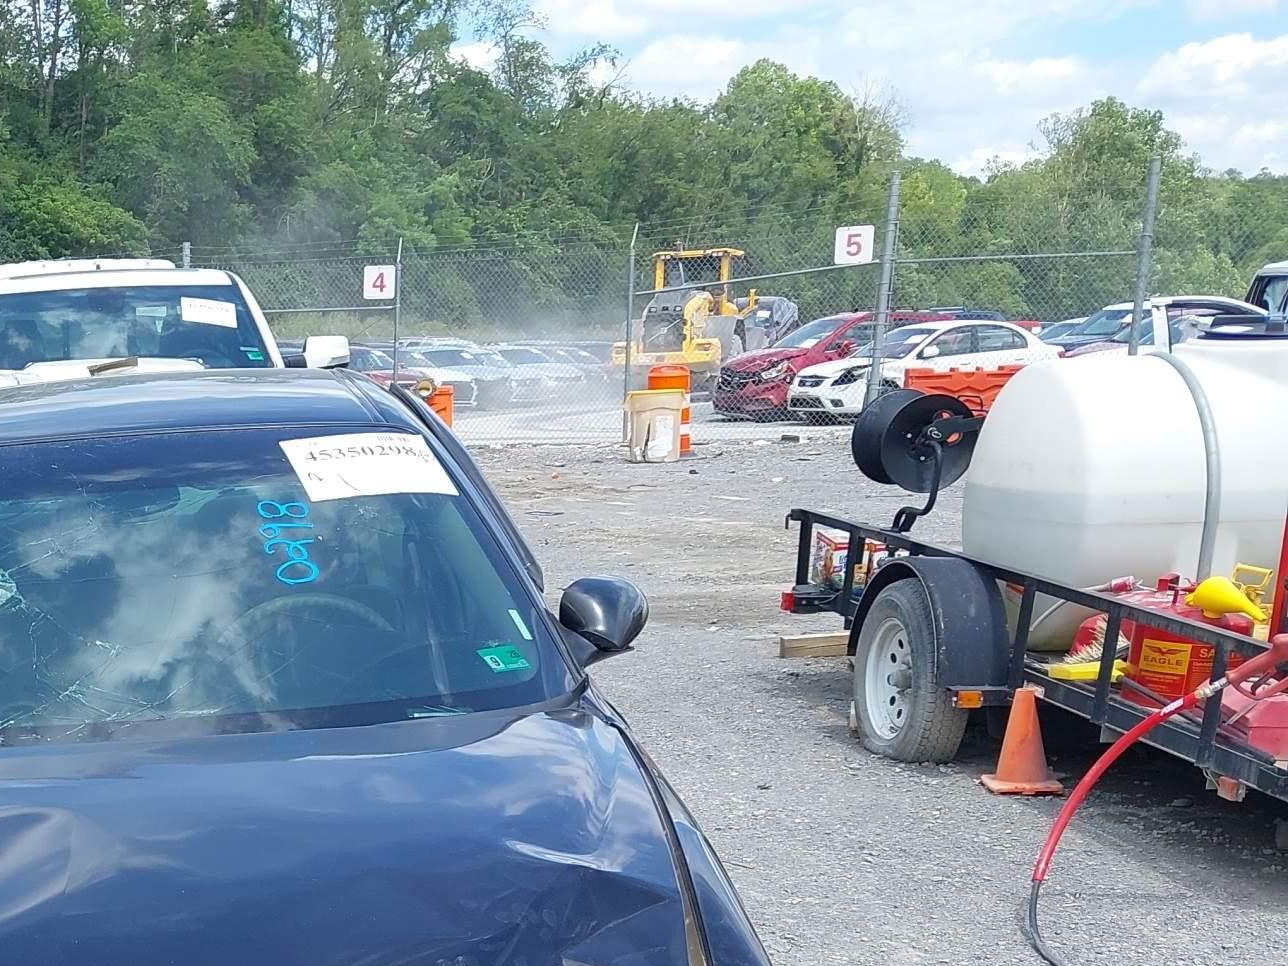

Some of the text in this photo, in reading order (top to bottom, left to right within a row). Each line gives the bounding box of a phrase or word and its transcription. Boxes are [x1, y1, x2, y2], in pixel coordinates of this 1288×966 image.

[846, 233, 862, 257] 5
[372, 272, 387, 293] 4
[257, 500, 320, 584] 0298
[1143, 655, 1184, 666] EAGLE
